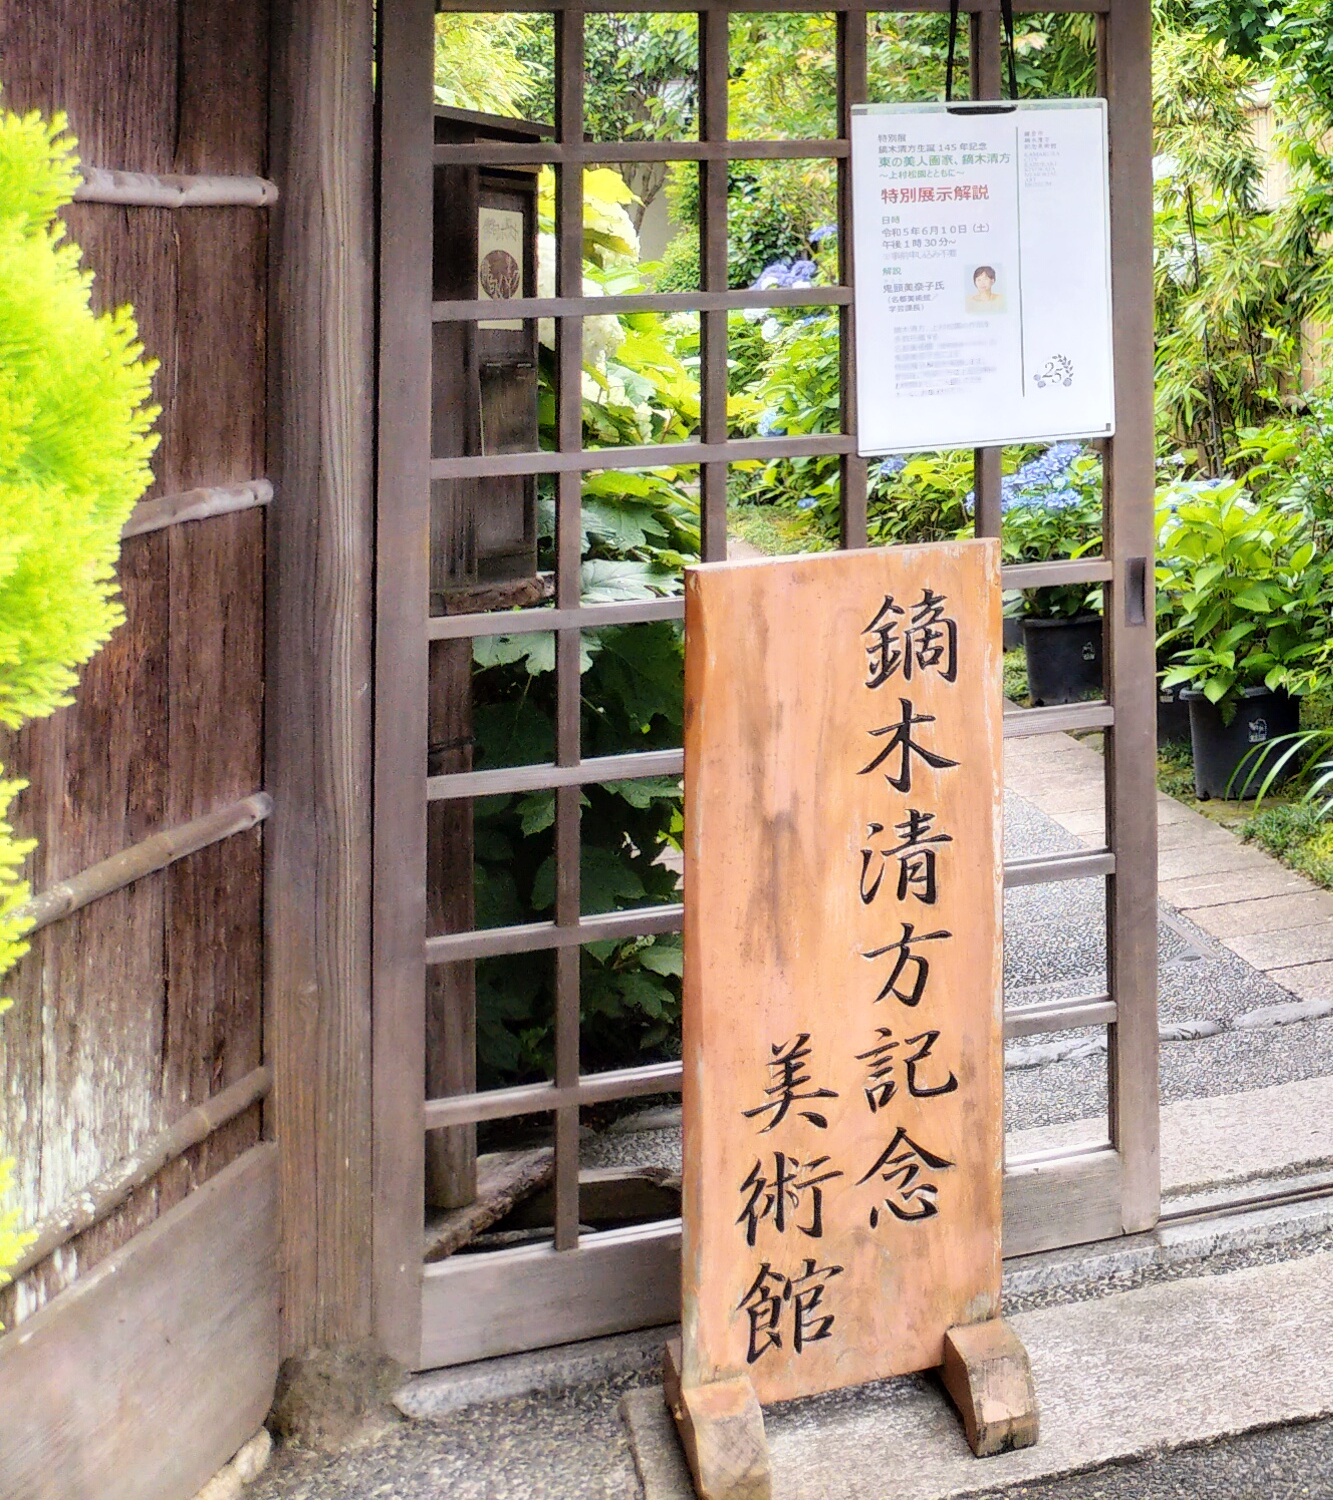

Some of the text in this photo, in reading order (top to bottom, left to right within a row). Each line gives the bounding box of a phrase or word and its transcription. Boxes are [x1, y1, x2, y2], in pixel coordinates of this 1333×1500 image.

[877, 133, 907, 143] 特別展
[878, 152, 1011, 168] 東の美人画家、鏑木清方
[880, 184, 990, 204] 特別展示解説
[881, 215, 900, 225] 日時
[882, 266, 902, 276] 解説
[854, 586, 961, 1231] 鏑木清方記念
[735, 1033, 845, 1366] 美術館
